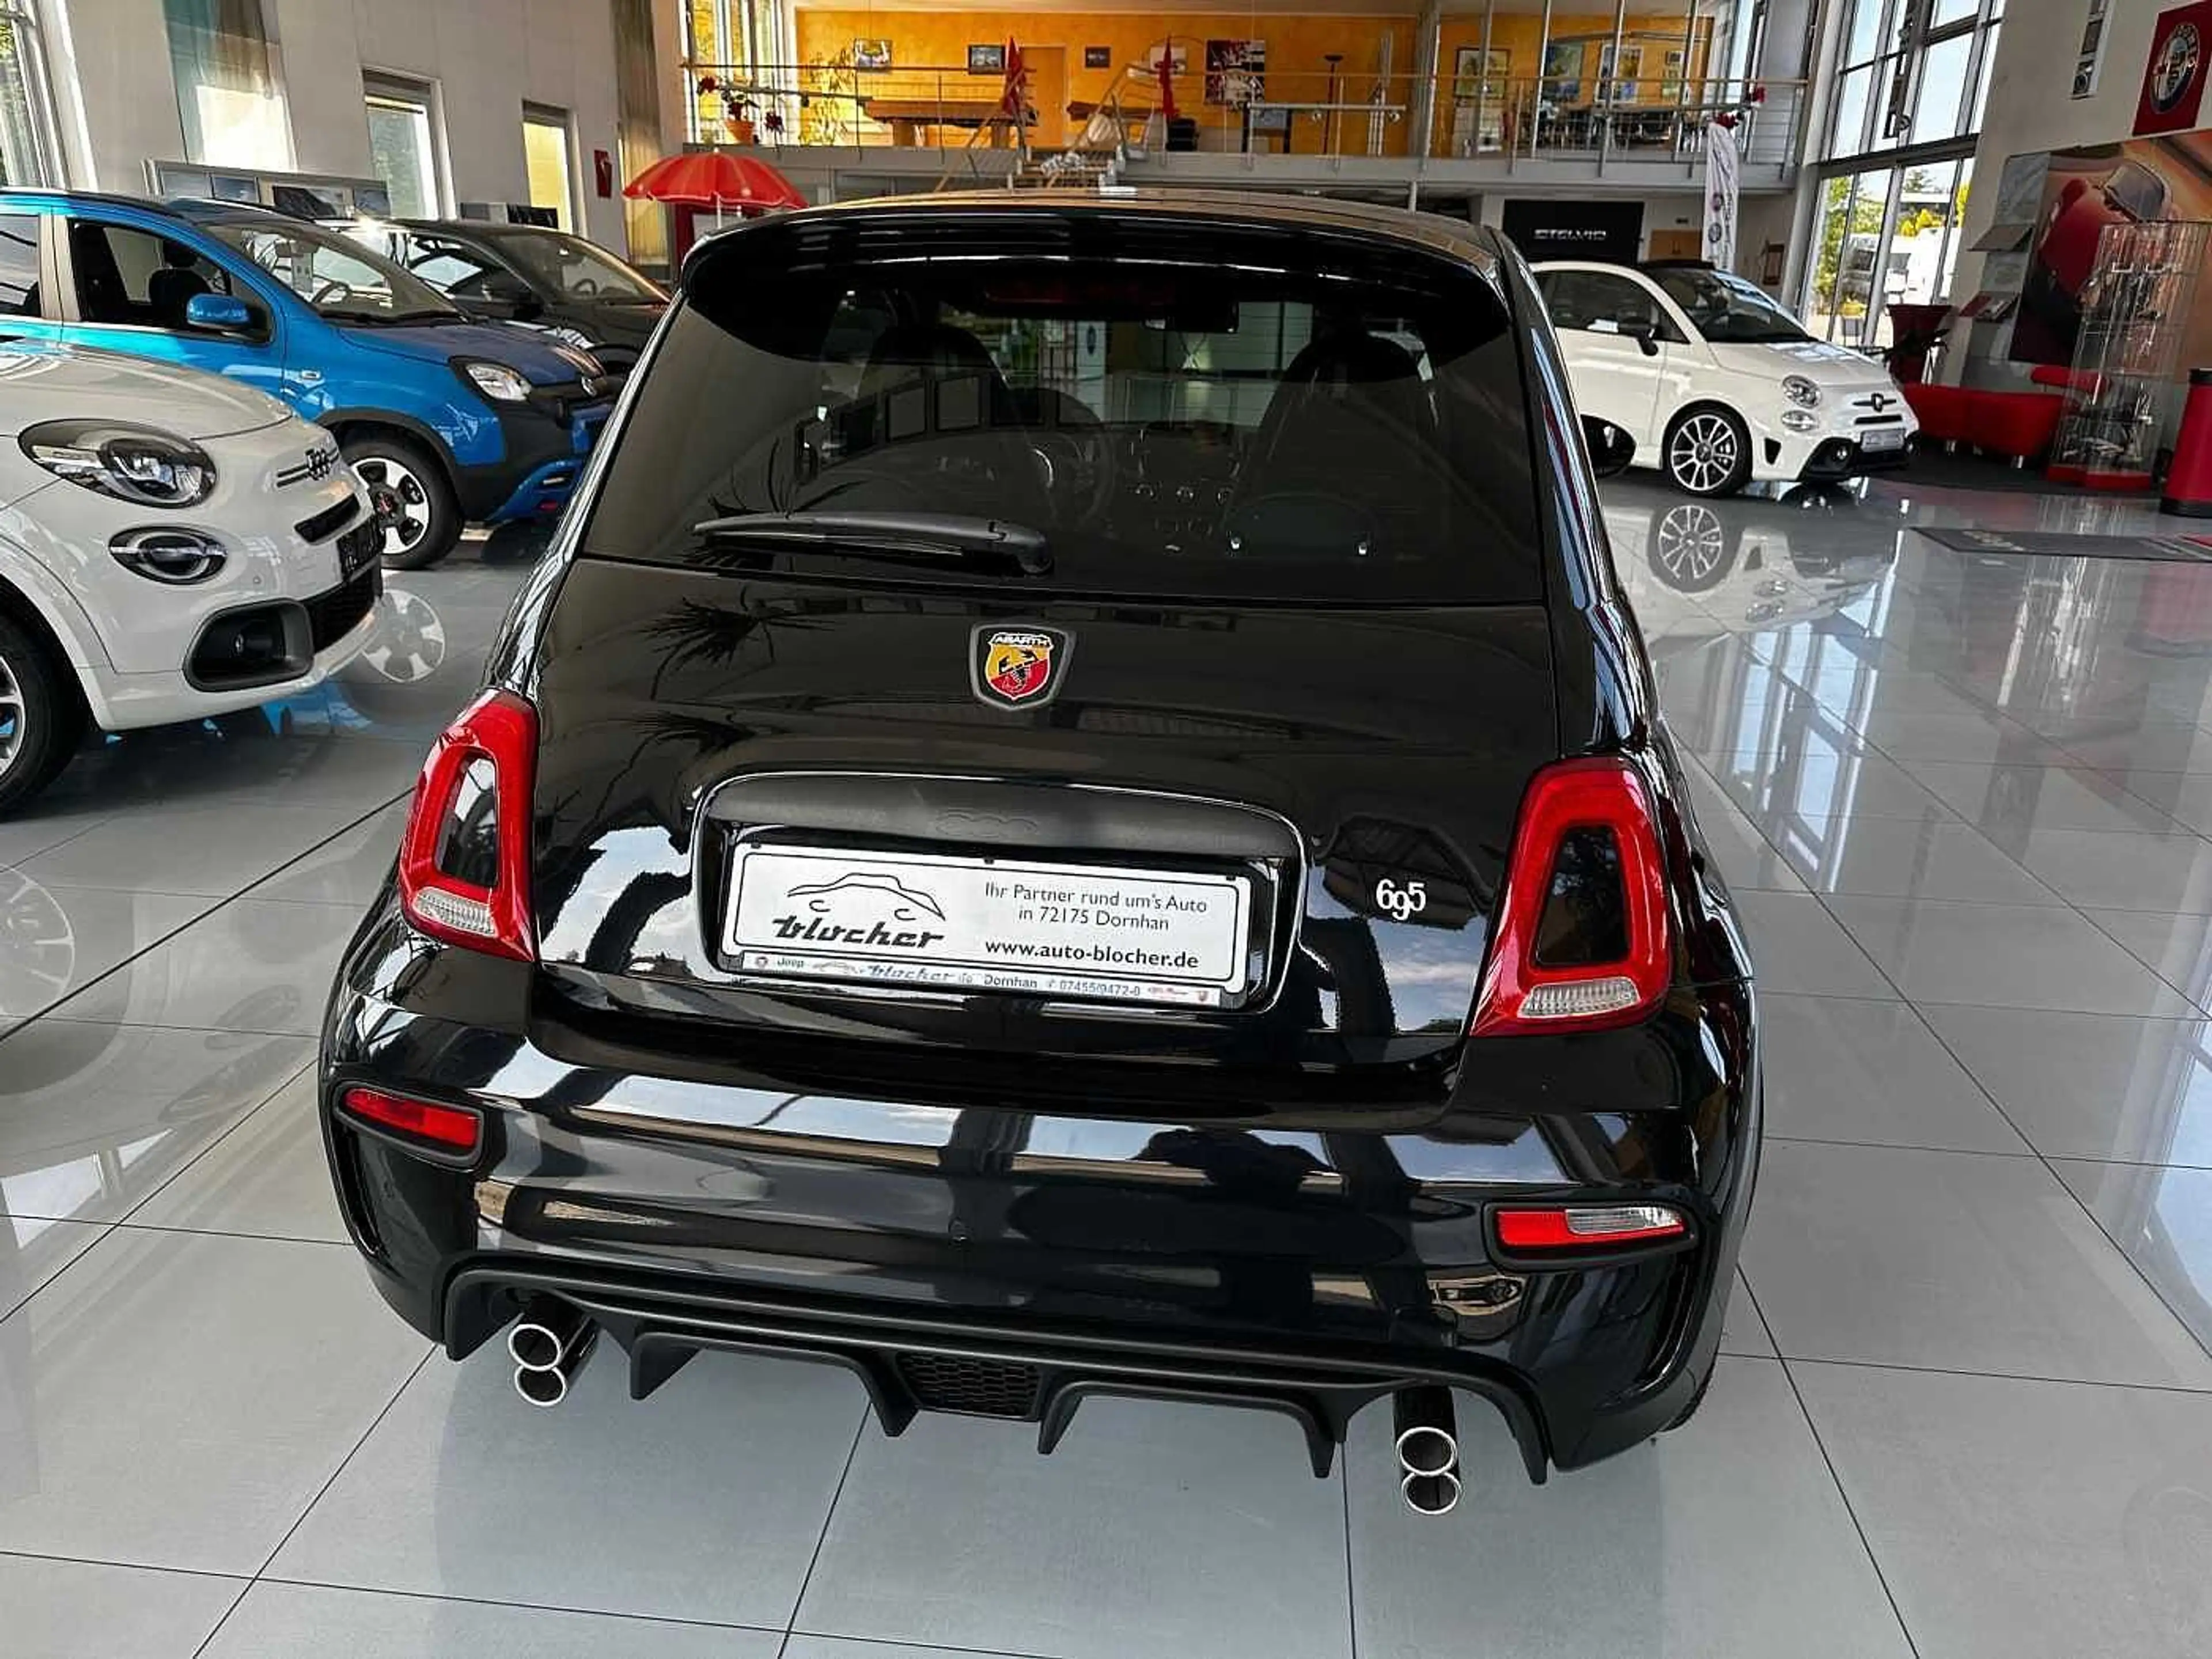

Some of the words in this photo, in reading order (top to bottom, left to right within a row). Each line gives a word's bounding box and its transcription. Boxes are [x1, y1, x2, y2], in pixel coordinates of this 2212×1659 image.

[995, 635, 1050, 646] ABARTH
[986, 881, 1008, 899] Ihr
[1014, 884, 1075, 903] Partner
[1081, 891, 1120, 907] rund
[1125, 893, 1162, 910] um's
[1165, 895, 1207, 913] Auto
[1376, 878, 1426, 921] 695
[1018, 907, 1033, 921] in
[1039, 907, 1089, 925] 72175
[1096, 910, 1169, 931] Dornhan
[985, 941, 1199, 968] www.auto-blocher.de
[984, 974, 1037, 988] Dornhan
